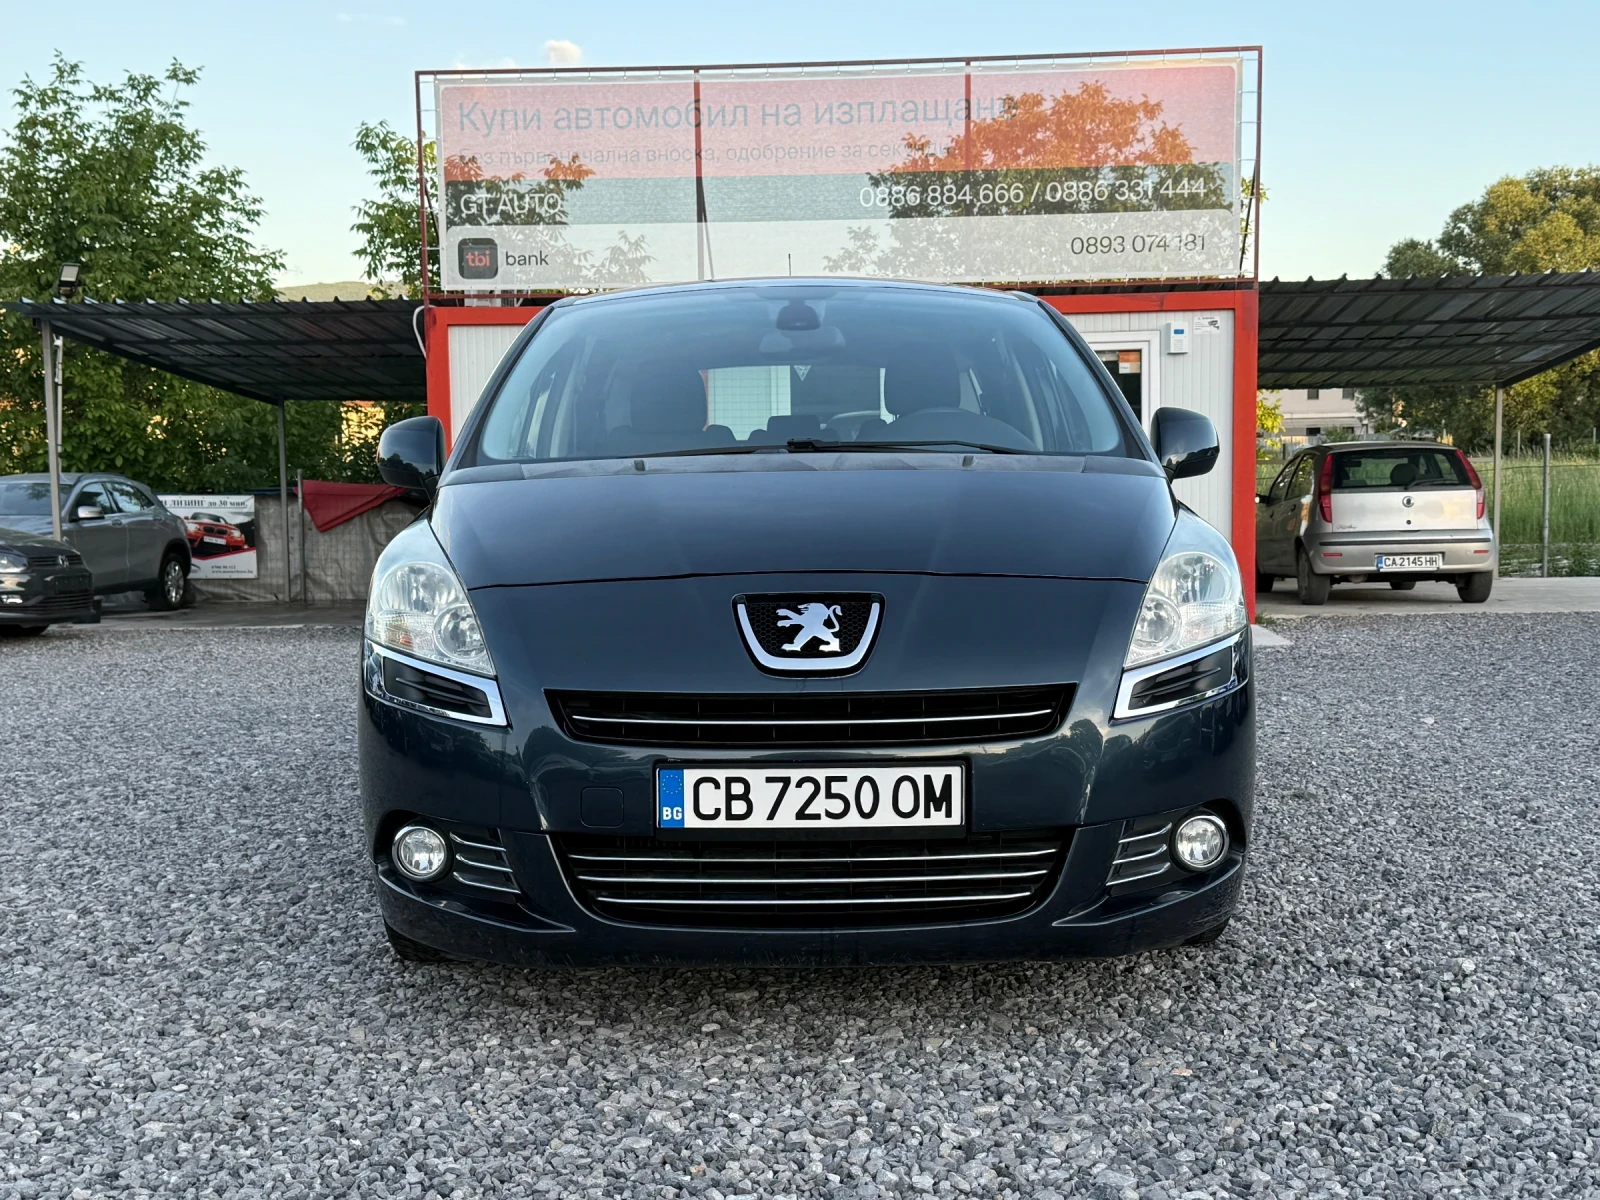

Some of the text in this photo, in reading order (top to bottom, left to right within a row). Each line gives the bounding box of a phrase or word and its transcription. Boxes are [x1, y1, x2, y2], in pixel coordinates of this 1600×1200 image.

[458, 102, 542, 138] Купи
[553, 98, 749, 131] автомобил
[761, 102, 802, 128] на
[726, 144, 837, 163] одобрение
[841, 144, 863, 158] за
[460, 192, 562, 215] GT AUTO
[859, 176, 1208, 208] 0886 884 666 / 0886 331 444
[1070, 232, 1206, 255] 0893 074 181
[465, 249, 550, 267] tbi bank
[1384, 556, 1438, 567] CA 2145 HH
[692, 773, 953, 821] CB 7250 OM
[662, 805, 683, 821] BG
